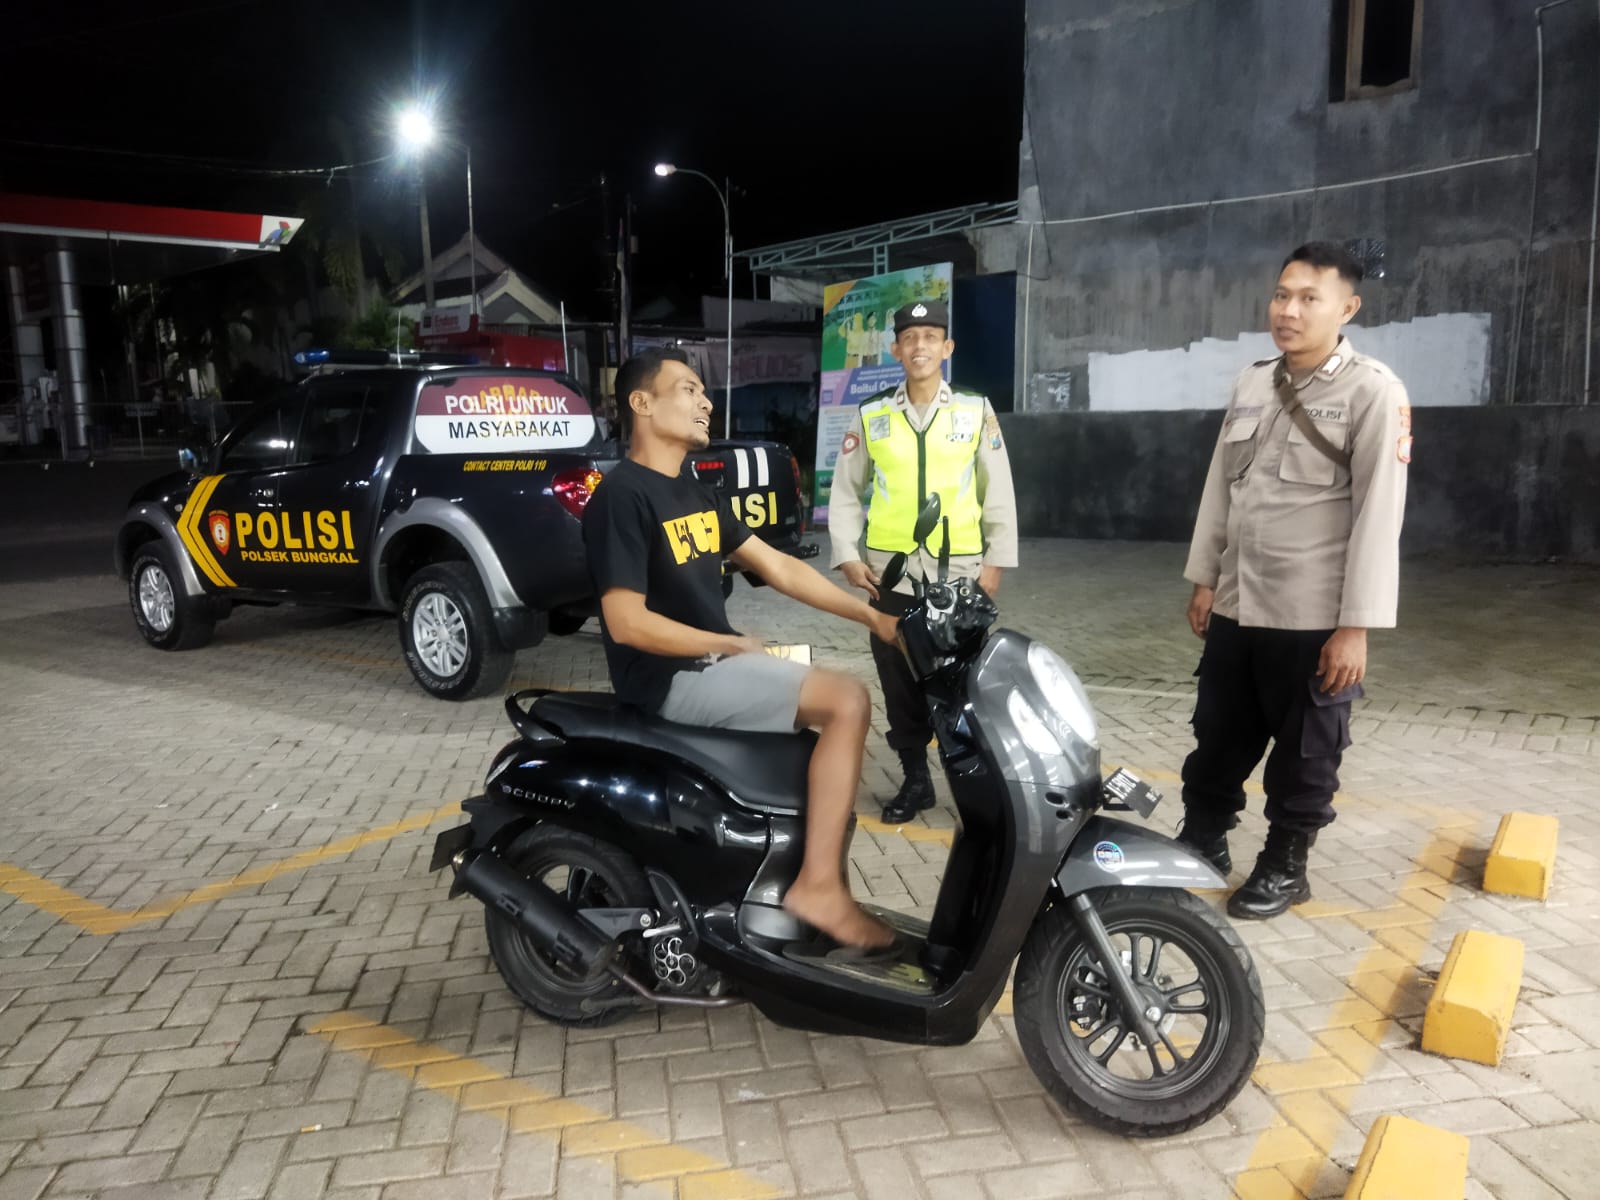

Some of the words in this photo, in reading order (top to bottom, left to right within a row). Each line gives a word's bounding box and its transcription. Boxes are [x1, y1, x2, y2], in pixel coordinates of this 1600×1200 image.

[850, 381, 877, 395] Baitul
[445, 394, 505, 414] POLRI
[509, 396, 569, 414] UNTUK
[449, 420, 571, 439] MASYARAKAT
[463, 460, 490, 472] CONTACT
[490, 460, 515, 471] CENTER
[534, 459, 547, 471] 110
[235, 510, 355, 550] POLISI
[241, 550, 289, 563] POLSEK
[291, 551, 360, 564] BUNGKAL
